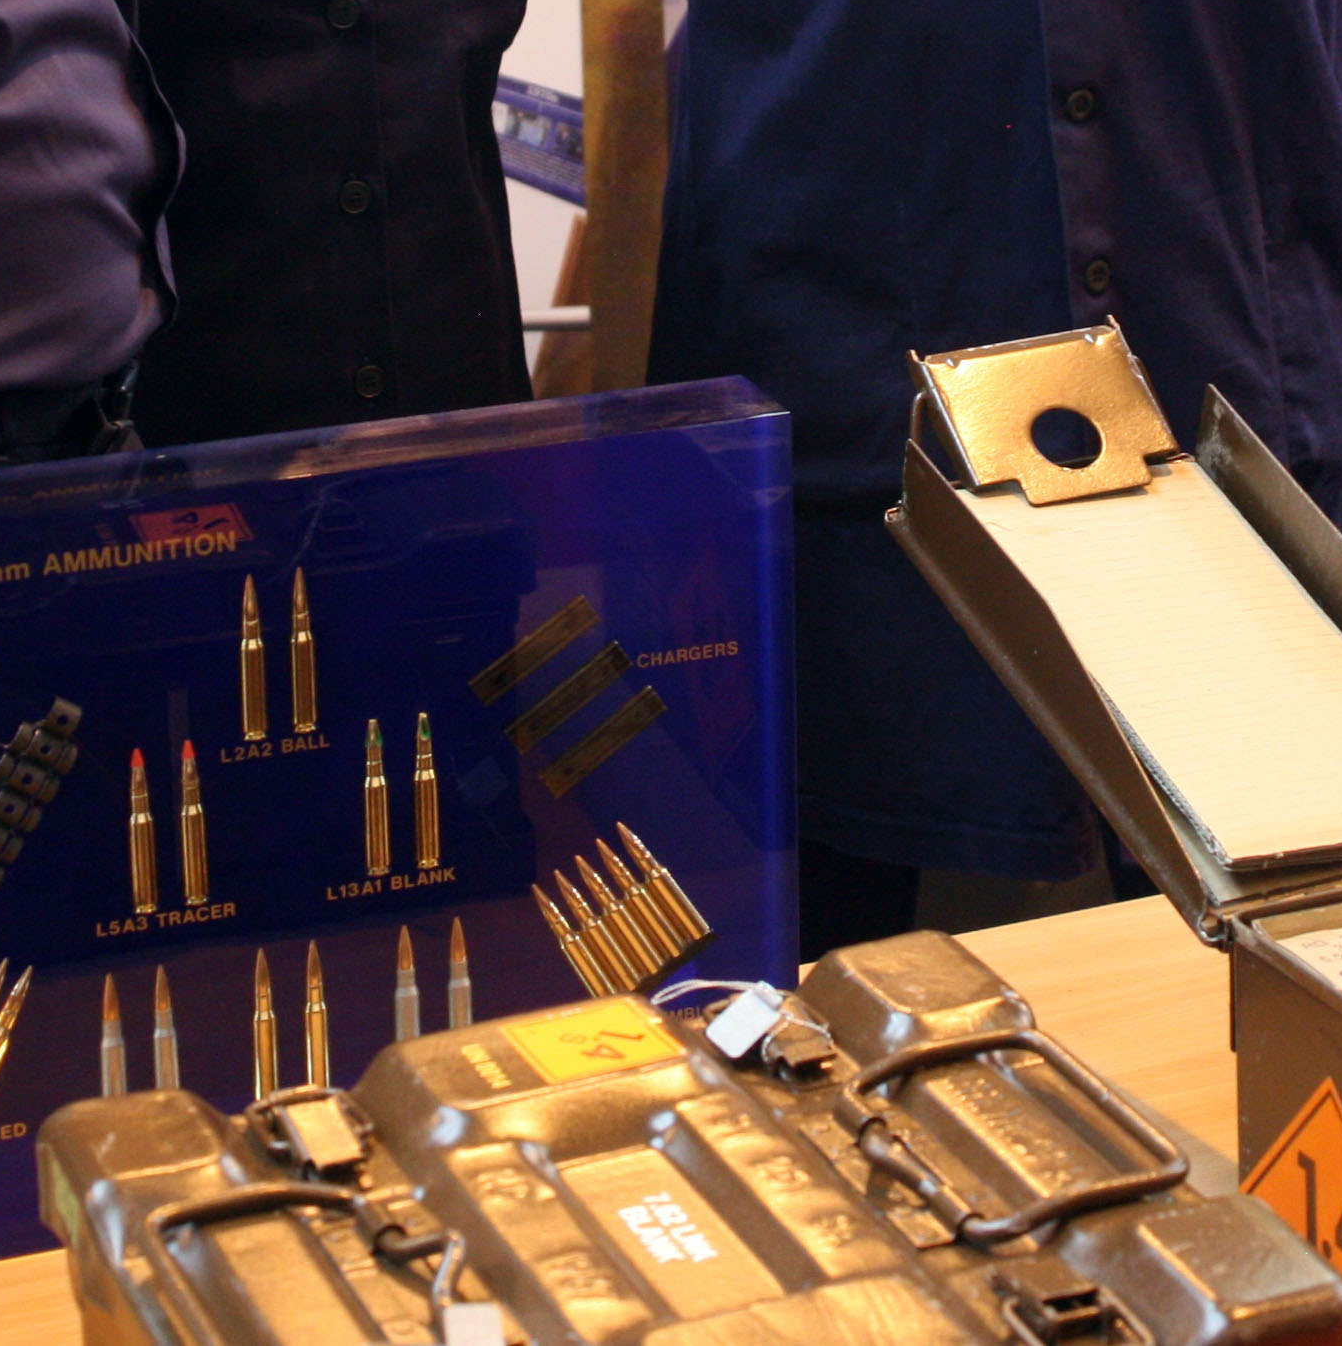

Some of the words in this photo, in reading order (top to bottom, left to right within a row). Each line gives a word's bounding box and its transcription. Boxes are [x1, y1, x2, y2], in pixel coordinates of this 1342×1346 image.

[43, 531, 236, 576] AMMUNITION
[636, 641, 739, 669] CHARGERS
[221, 742, 273, 763] L2A2
[282, 734, 330, 754] BALL
[327, 879, 382, 901] L13A1
[391, 867, 456, 890] BLANK
[96, 916, 148, 937] L5A3
[156, 903, 236, 929] TRACER
